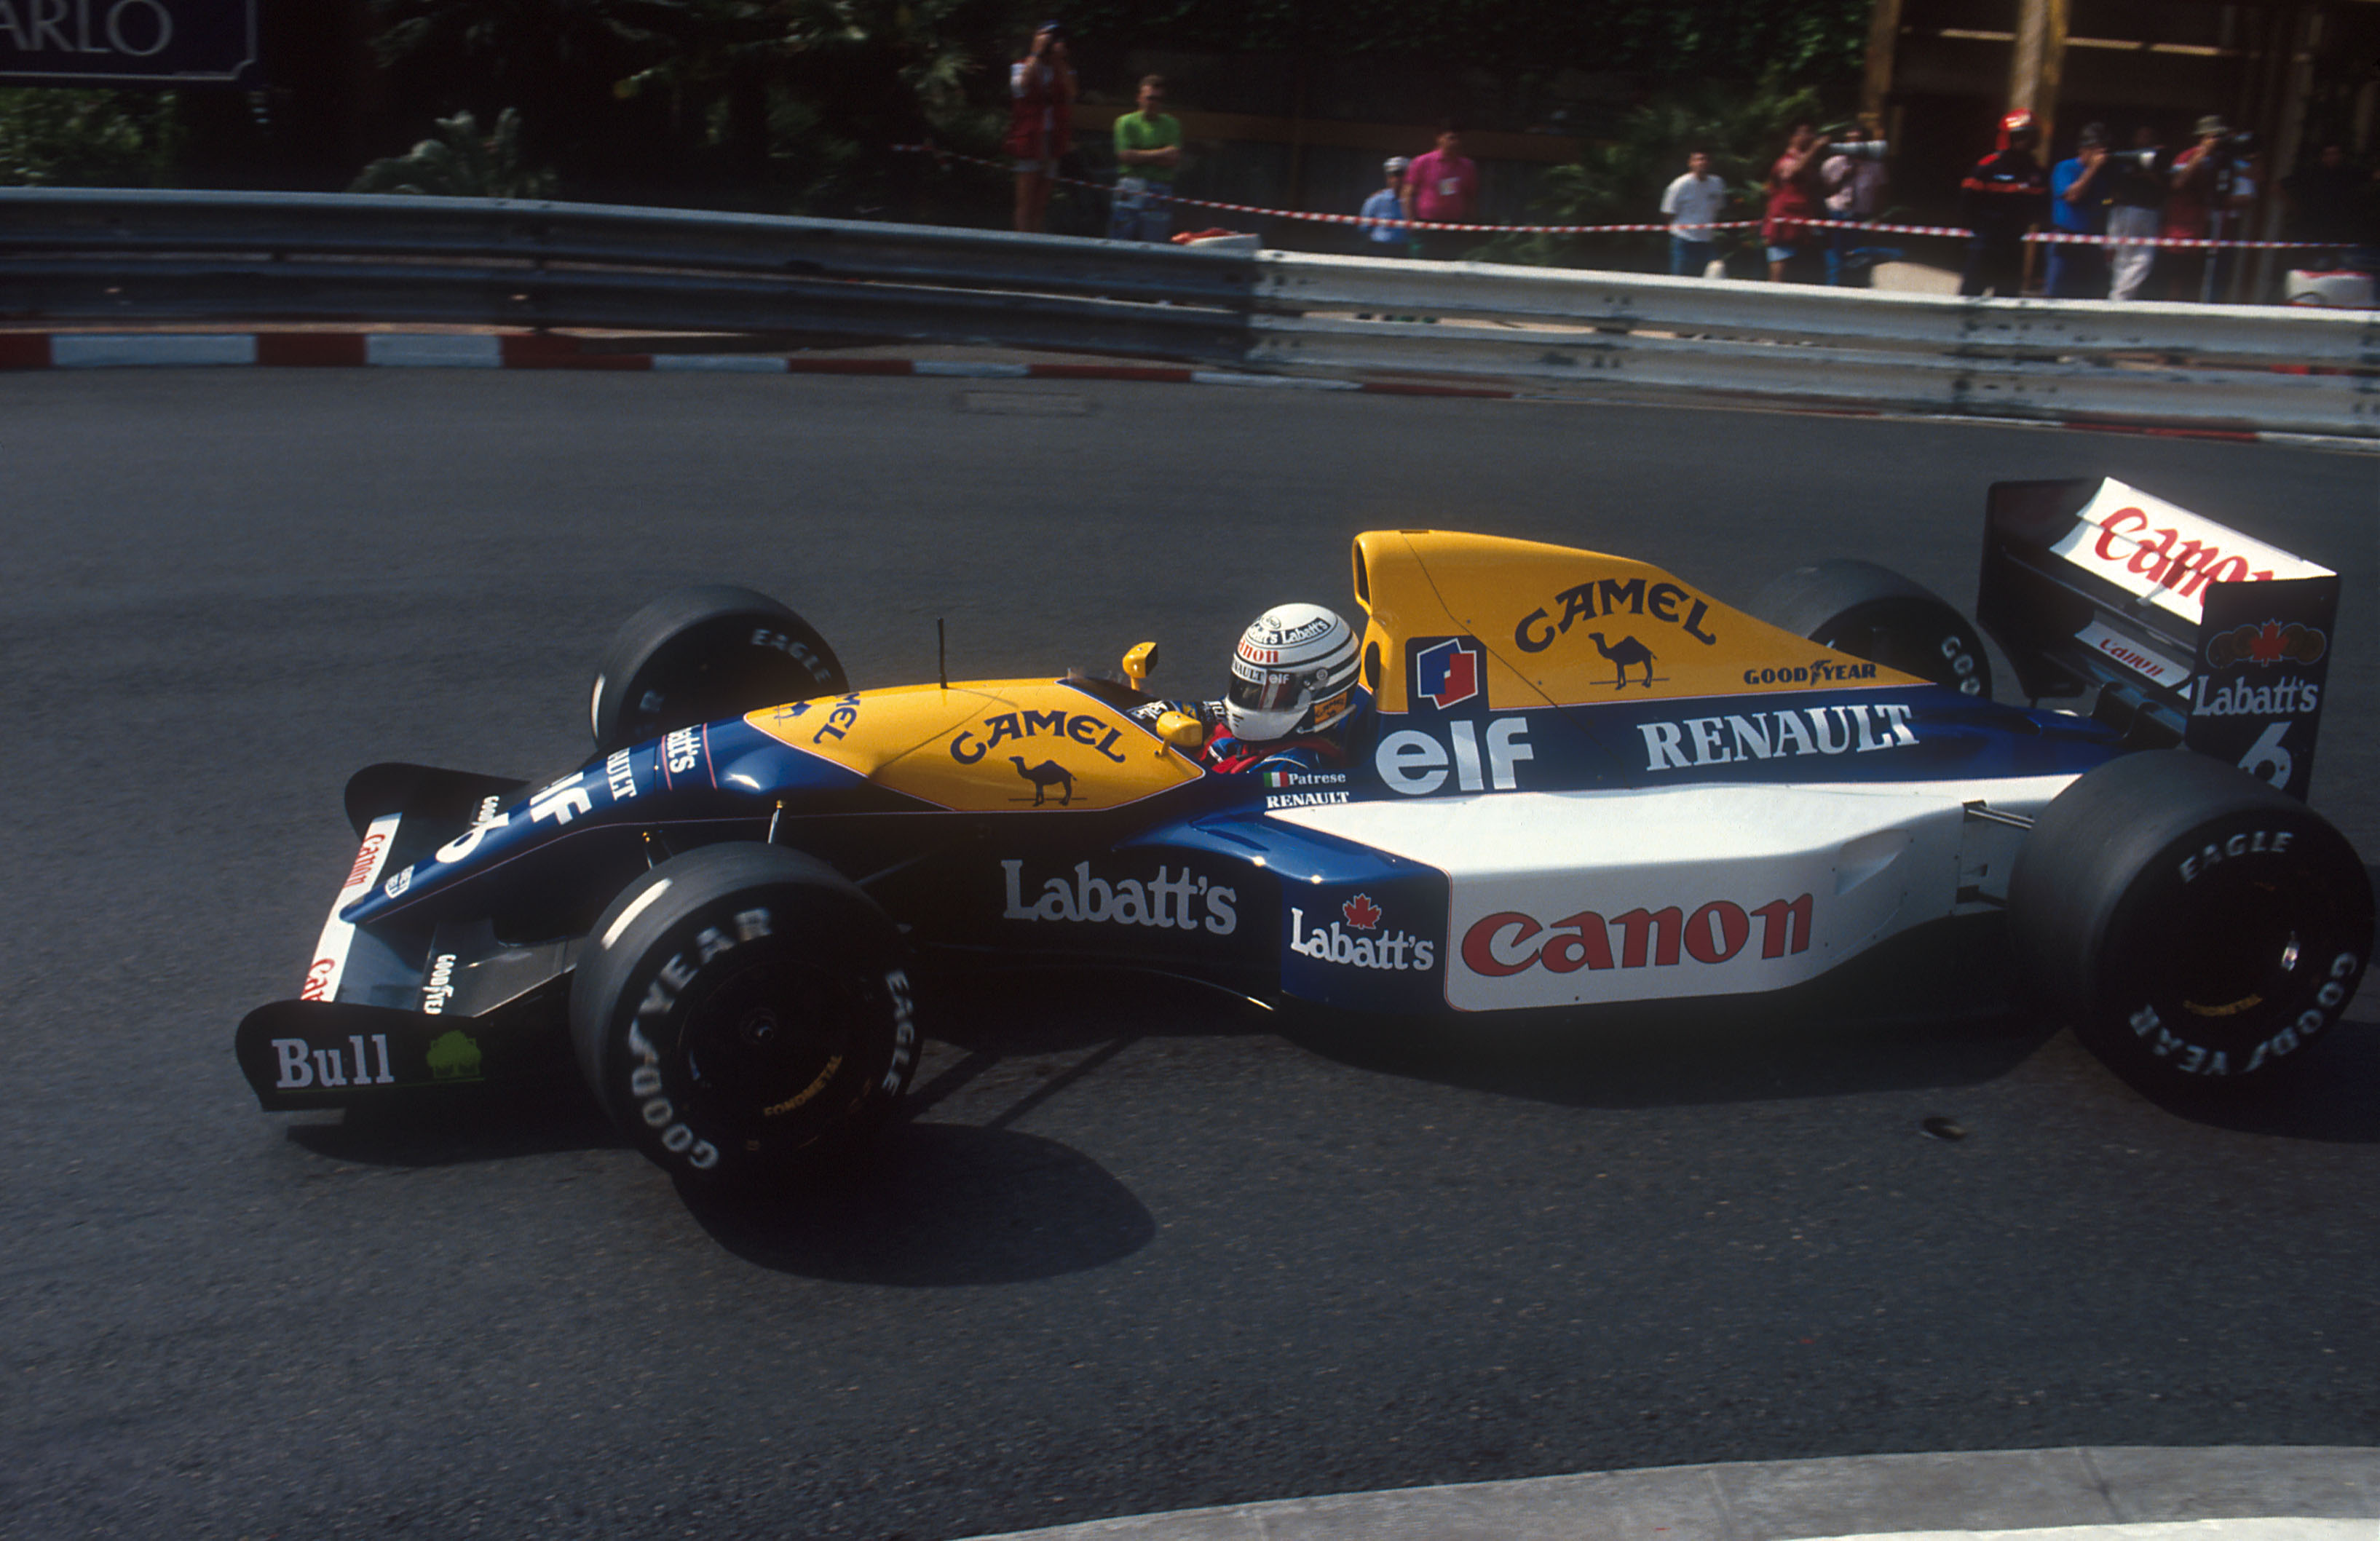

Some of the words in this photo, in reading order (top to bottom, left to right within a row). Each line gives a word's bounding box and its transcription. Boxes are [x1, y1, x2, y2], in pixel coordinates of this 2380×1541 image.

[2095, 507, 2273, 609] Cano
[1515, 579, 1716, 653] CAMEL
[751, 628, 832, 684] EAGLE
[1269, 673, 1290, 684] elf
[1744, 659, 1877, 686] GOODYEAR
[2191, 676, 2319, 716] Labatt's
[950, 710, 1126, 764] CAMEL
[1375, 718, 1534, 795] elf
[1637, 705, 1919, 771] RENAULT
[2237, 722, 2292, 790] 6
[1266, 791, 1349, 808] RENAULT
[1288, 772, 1345, 785] Patrese
[2179, 831, 2294, 883] EAGLE
[1001, 859, 1237, 935] Labatt's
[1290, 908, 1434, 970] Labatt's
[1461, 893, 1814, 977] Canon
[272, 1034, 395, 1088] Bull
[882, 969, 914, 1096] EAGLE
